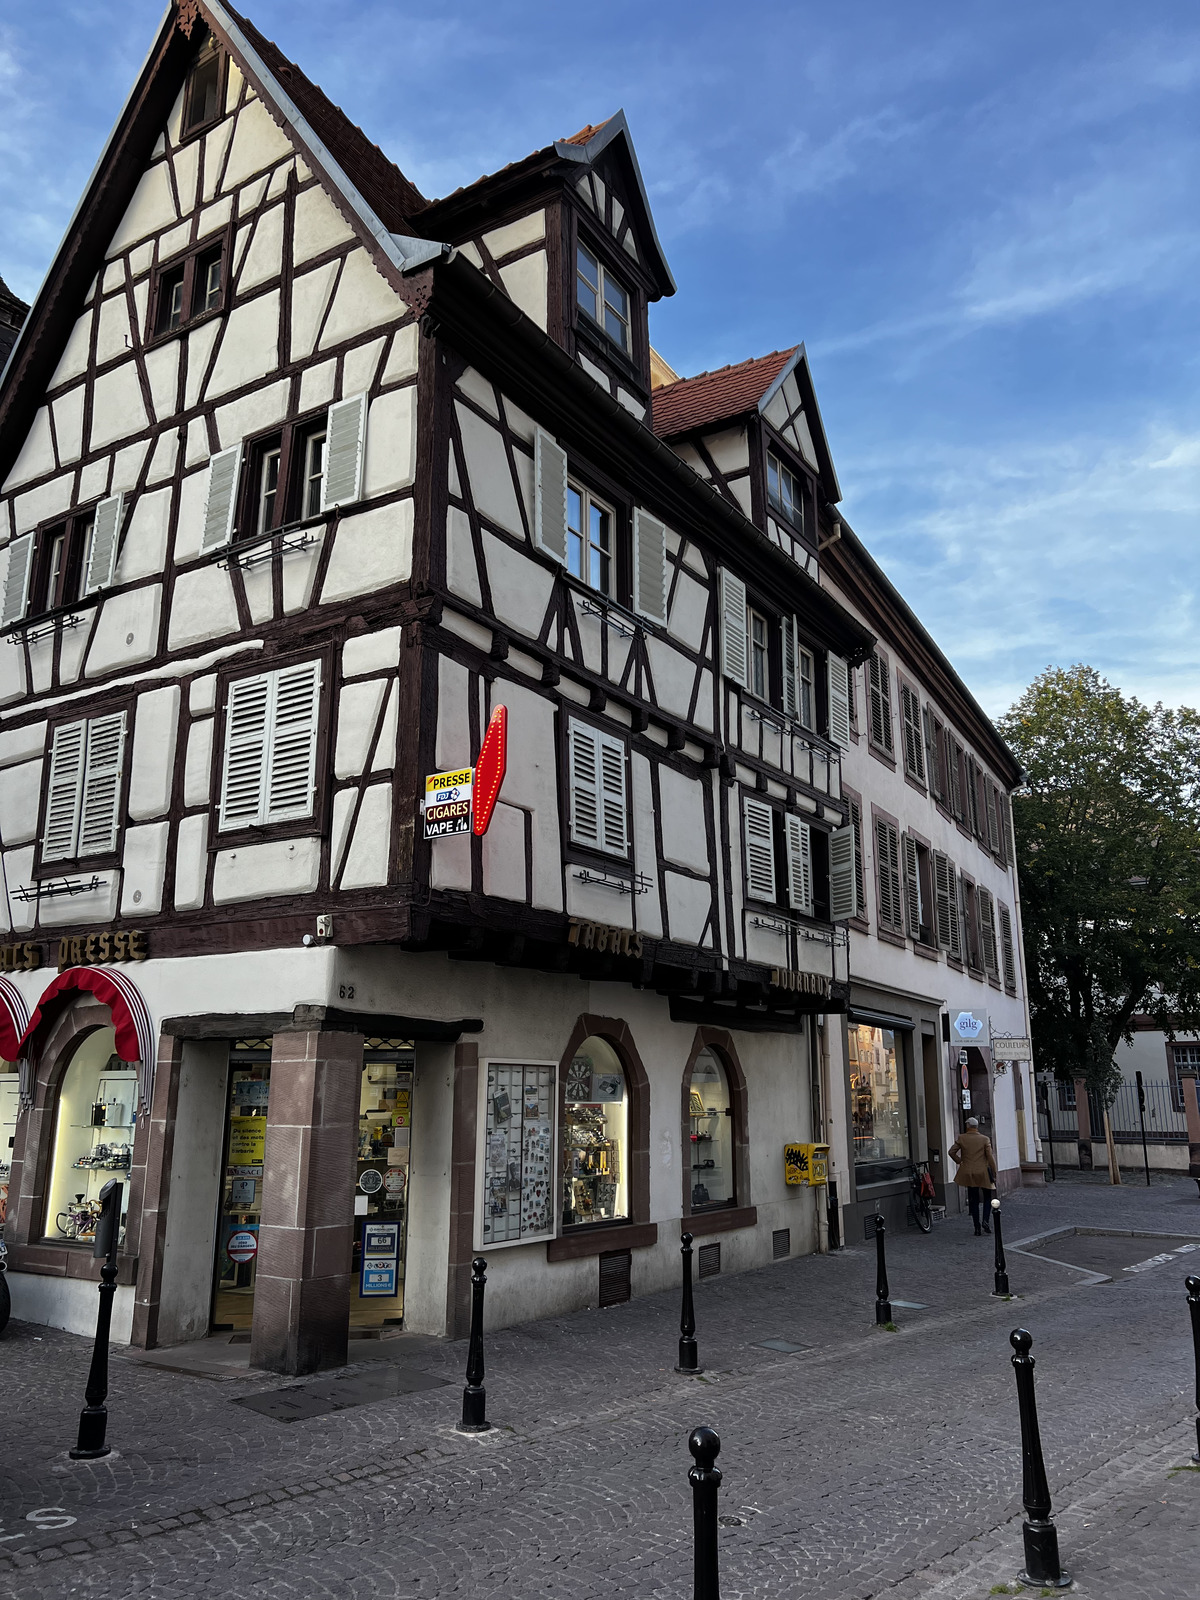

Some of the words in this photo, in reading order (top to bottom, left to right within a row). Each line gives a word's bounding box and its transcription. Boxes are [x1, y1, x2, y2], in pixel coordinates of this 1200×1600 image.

[433, 772, 470, 789] PRESSE
[437, 792, 450, 801] FDJ
[427, 802, 468, 820] CIGARES
[426, 821, 454, 835] VAPE
[568, 917, 643, 958] TABACS
[58, 930, 147, 968] PRESSE
[769, 967, 831, 998] JOURNAUX
[339, 985, 354, 999] 62
[959, 1019, 978, 1031] gilg
[995, 1041, 1029, 1049] COULEURS
[377, 1236, 387, 1244] 66
[377, 1274, 383, 1282] 3
